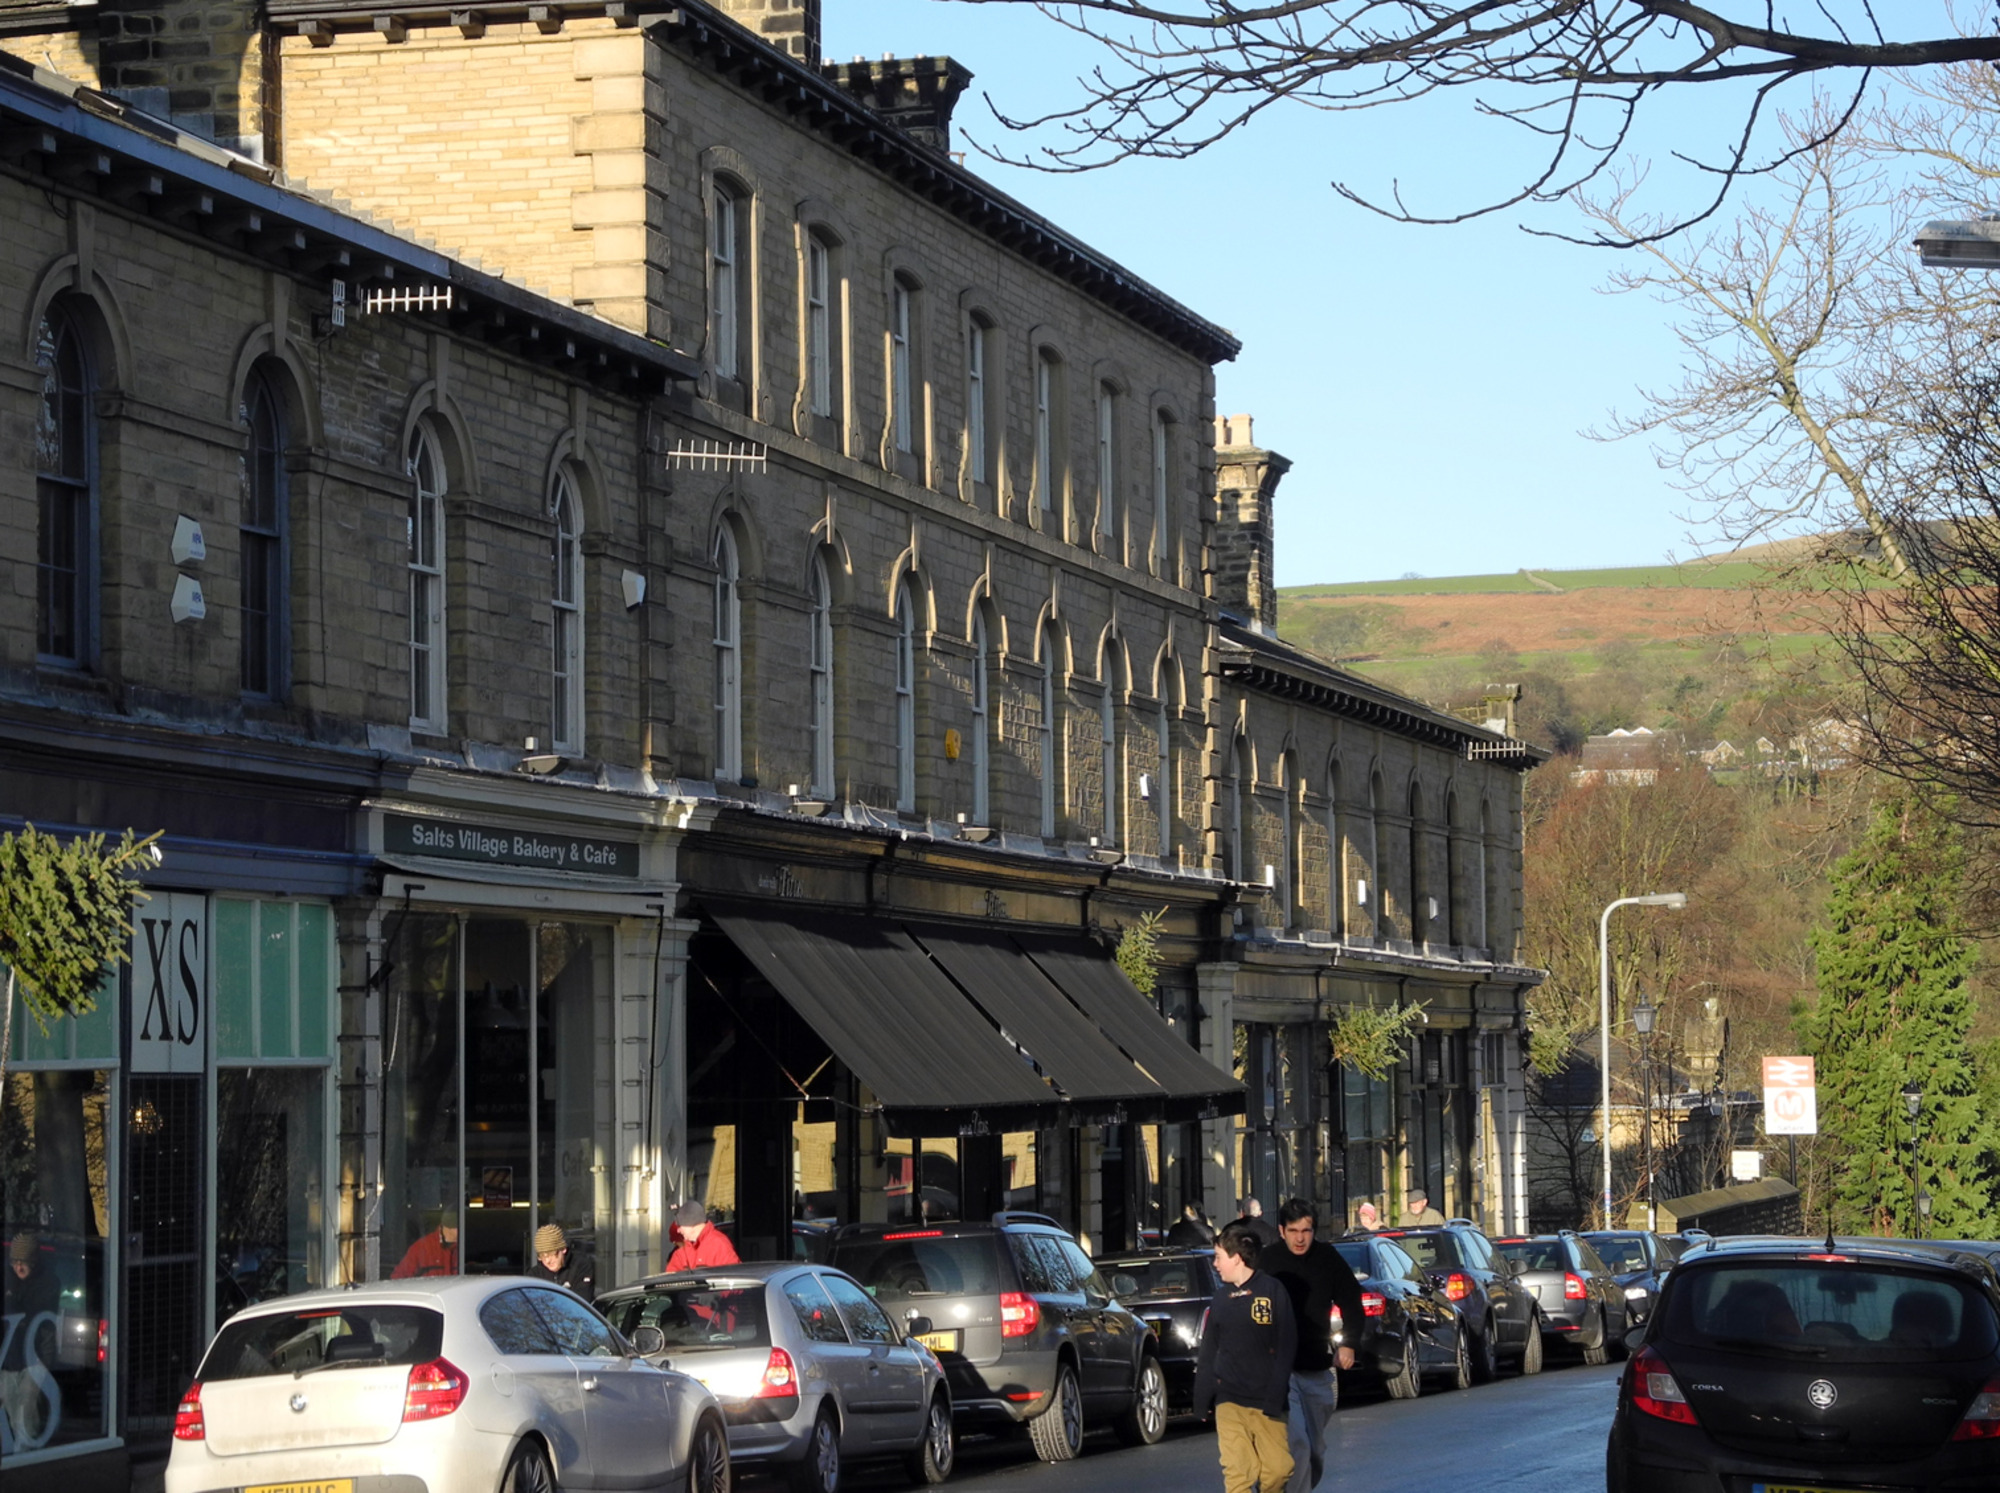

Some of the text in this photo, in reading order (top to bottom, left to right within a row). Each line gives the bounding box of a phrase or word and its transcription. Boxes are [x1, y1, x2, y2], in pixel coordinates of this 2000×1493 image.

[412, 824, 617, 865] Salts Village Bakery & Café
[139, 917, 199, 1046] XS
[1692, 1383, 1724, 1391] CORSA
